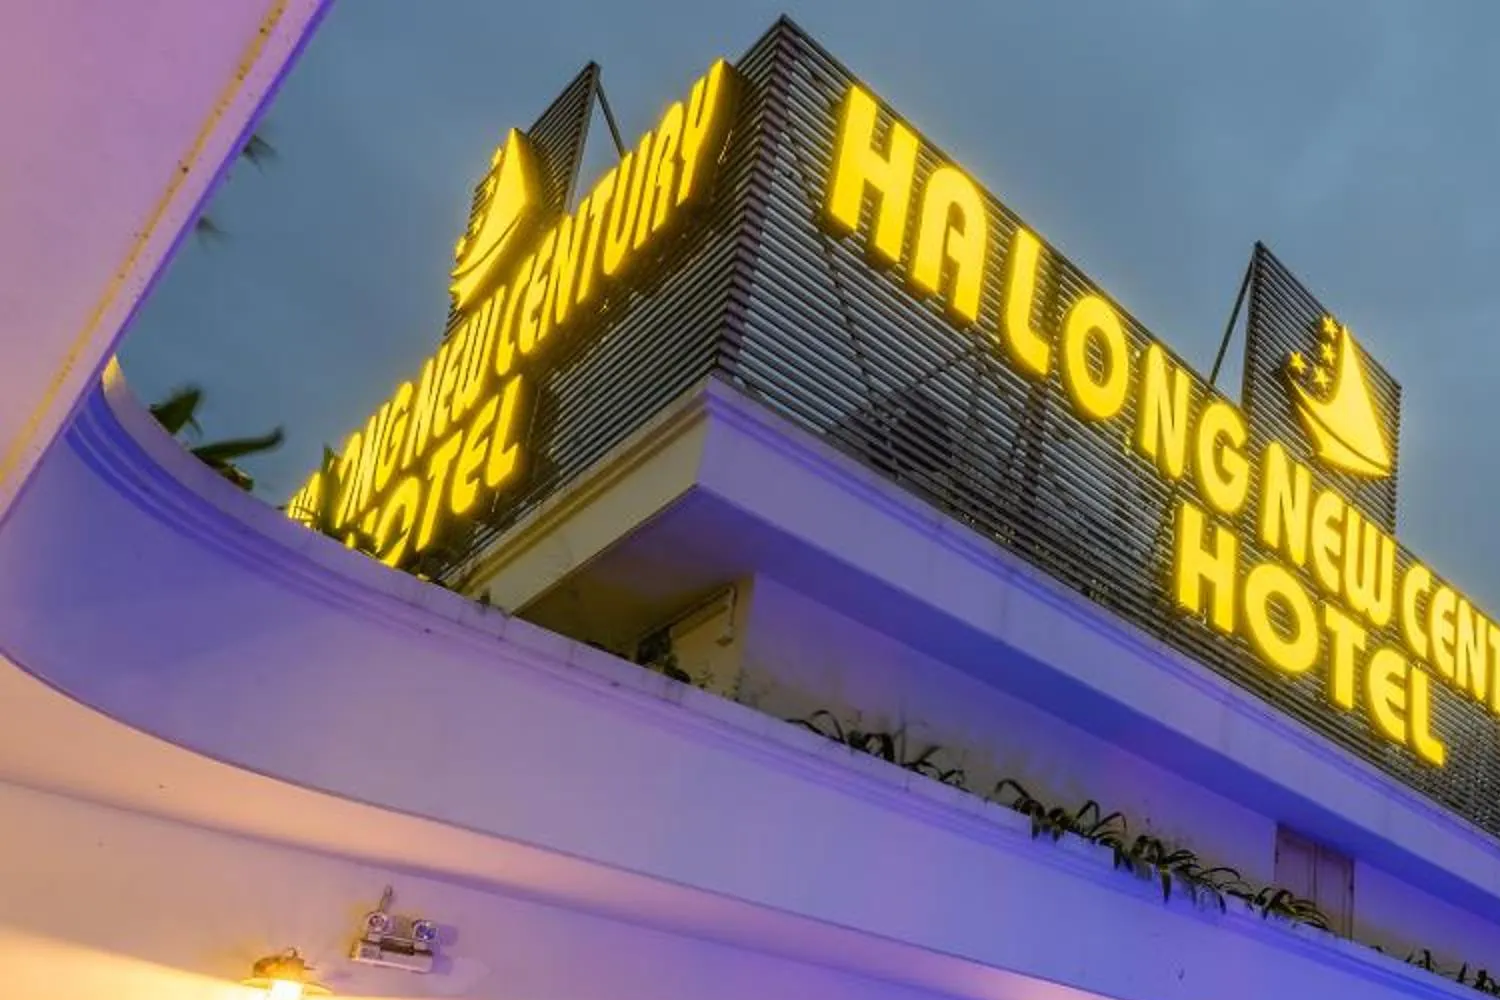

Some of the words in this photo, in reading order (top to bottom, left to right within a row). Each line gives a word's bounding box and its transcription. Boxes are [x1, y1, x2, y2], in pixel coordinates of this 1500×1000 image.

[402, 284, 506, 468] NEW
[496, 58, 727, 376] CENTURY
[828, 84, 1252, 515] HALONG
[1262, 442, 1397, 627] NEW
[1175, 502, 1446, 768] HOTEL
